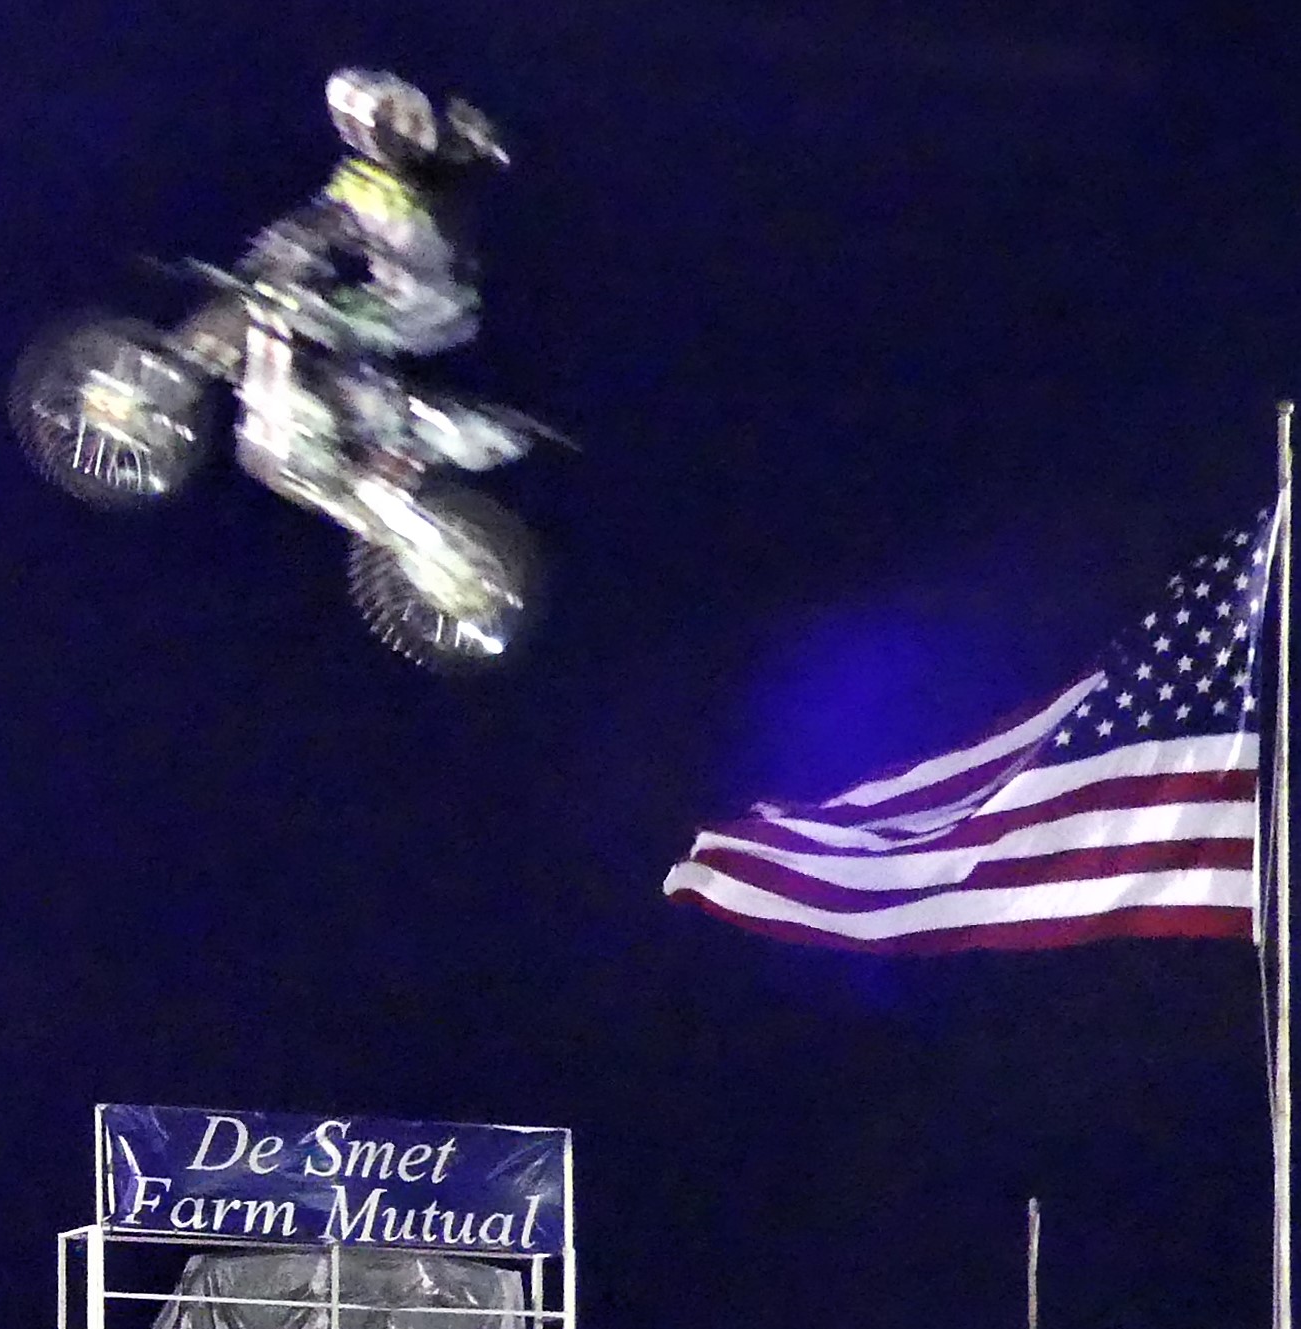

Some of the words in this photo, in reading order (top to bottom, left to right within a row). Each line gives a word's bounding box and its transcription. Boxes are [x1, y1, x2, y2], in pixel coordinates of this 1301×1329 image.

[186, 1115, 285, 1175] De
[303, 1119, 457, 1185] Smet
[119, 1175, 298, 1238] Farm
[317, 1184, 540, 1249] Mutual
